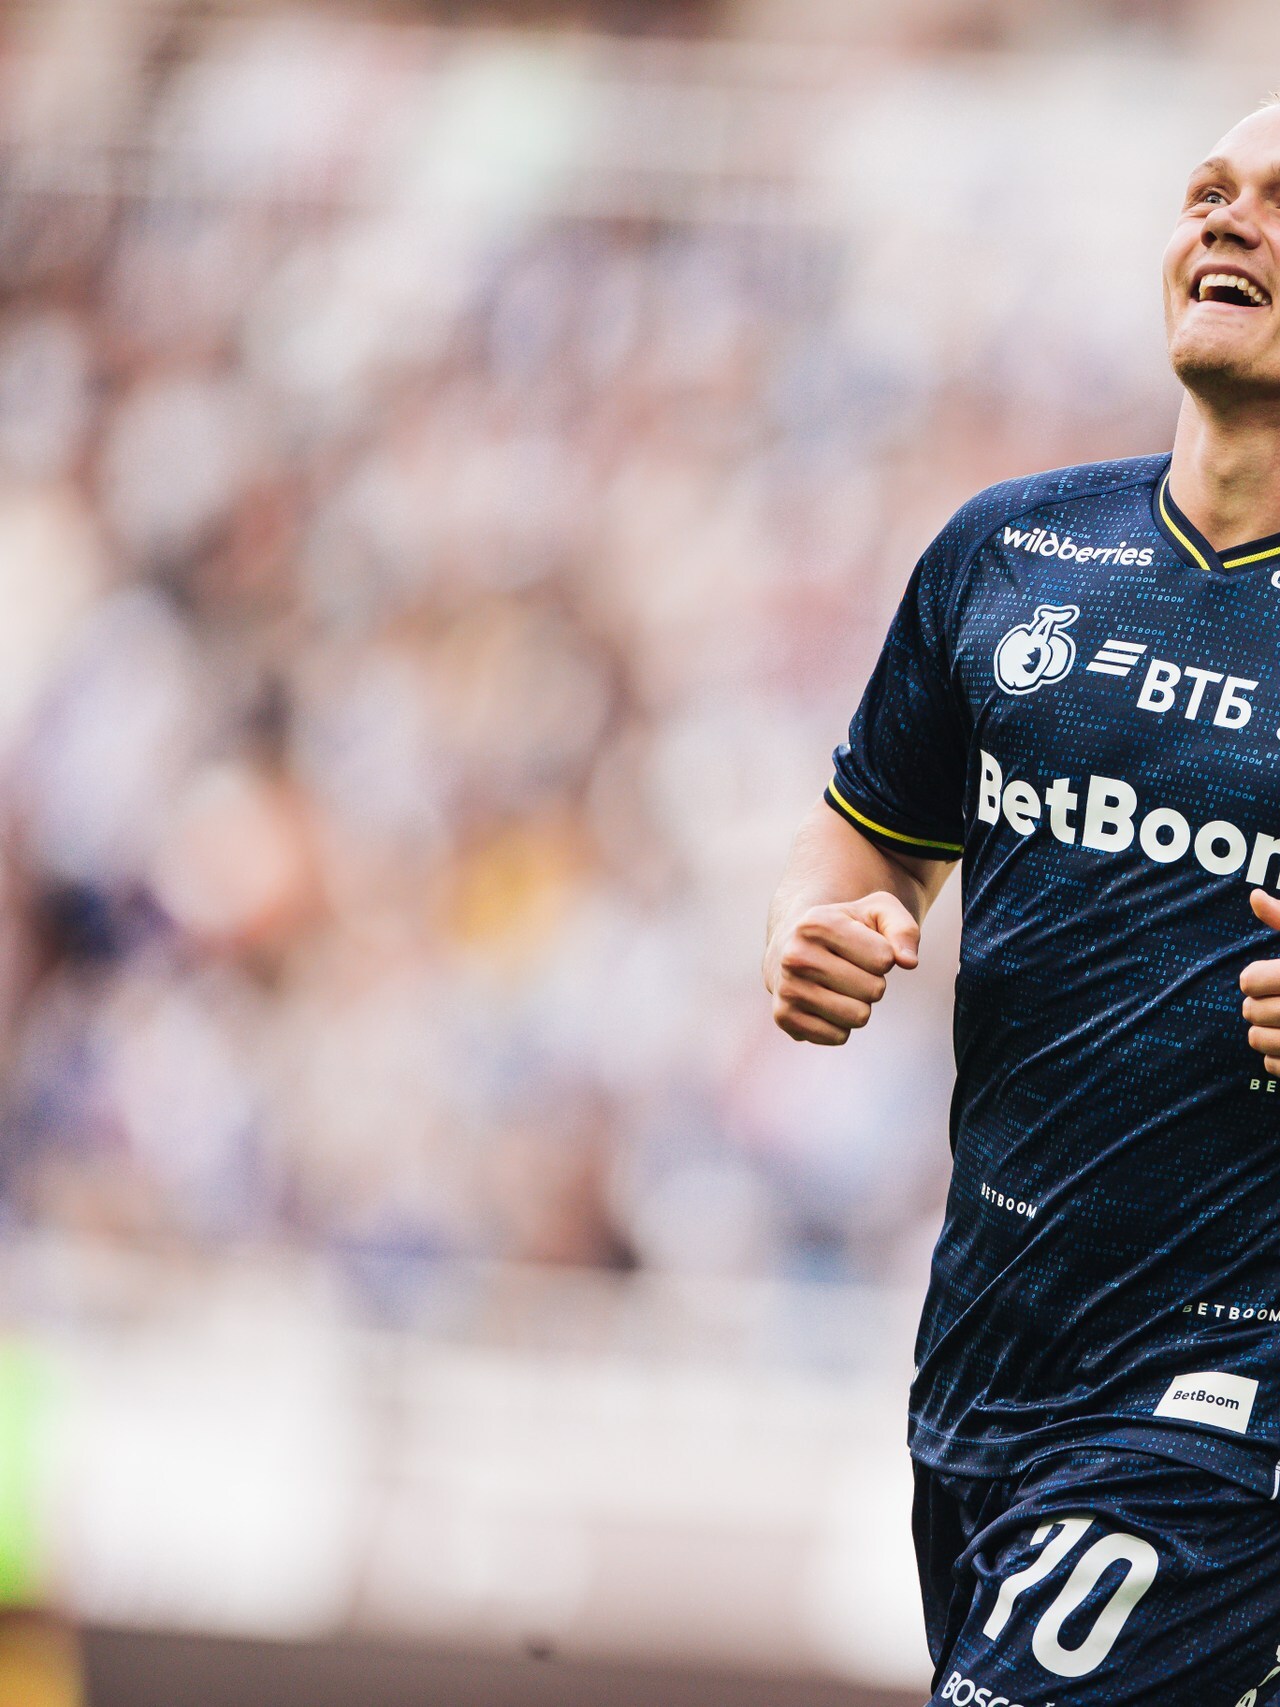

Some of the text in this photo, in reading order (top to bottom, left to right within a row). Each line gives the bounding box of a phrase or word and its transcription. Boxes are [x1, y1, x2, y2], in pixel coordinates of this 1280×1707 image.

[1003, 526, 1155, 566] wildberries
[1136, 658, 1260, 730] ВТБ
[1172, 1390, 1240, 1411] BetBoom
[982, 1514, 1159, 1678] 70
